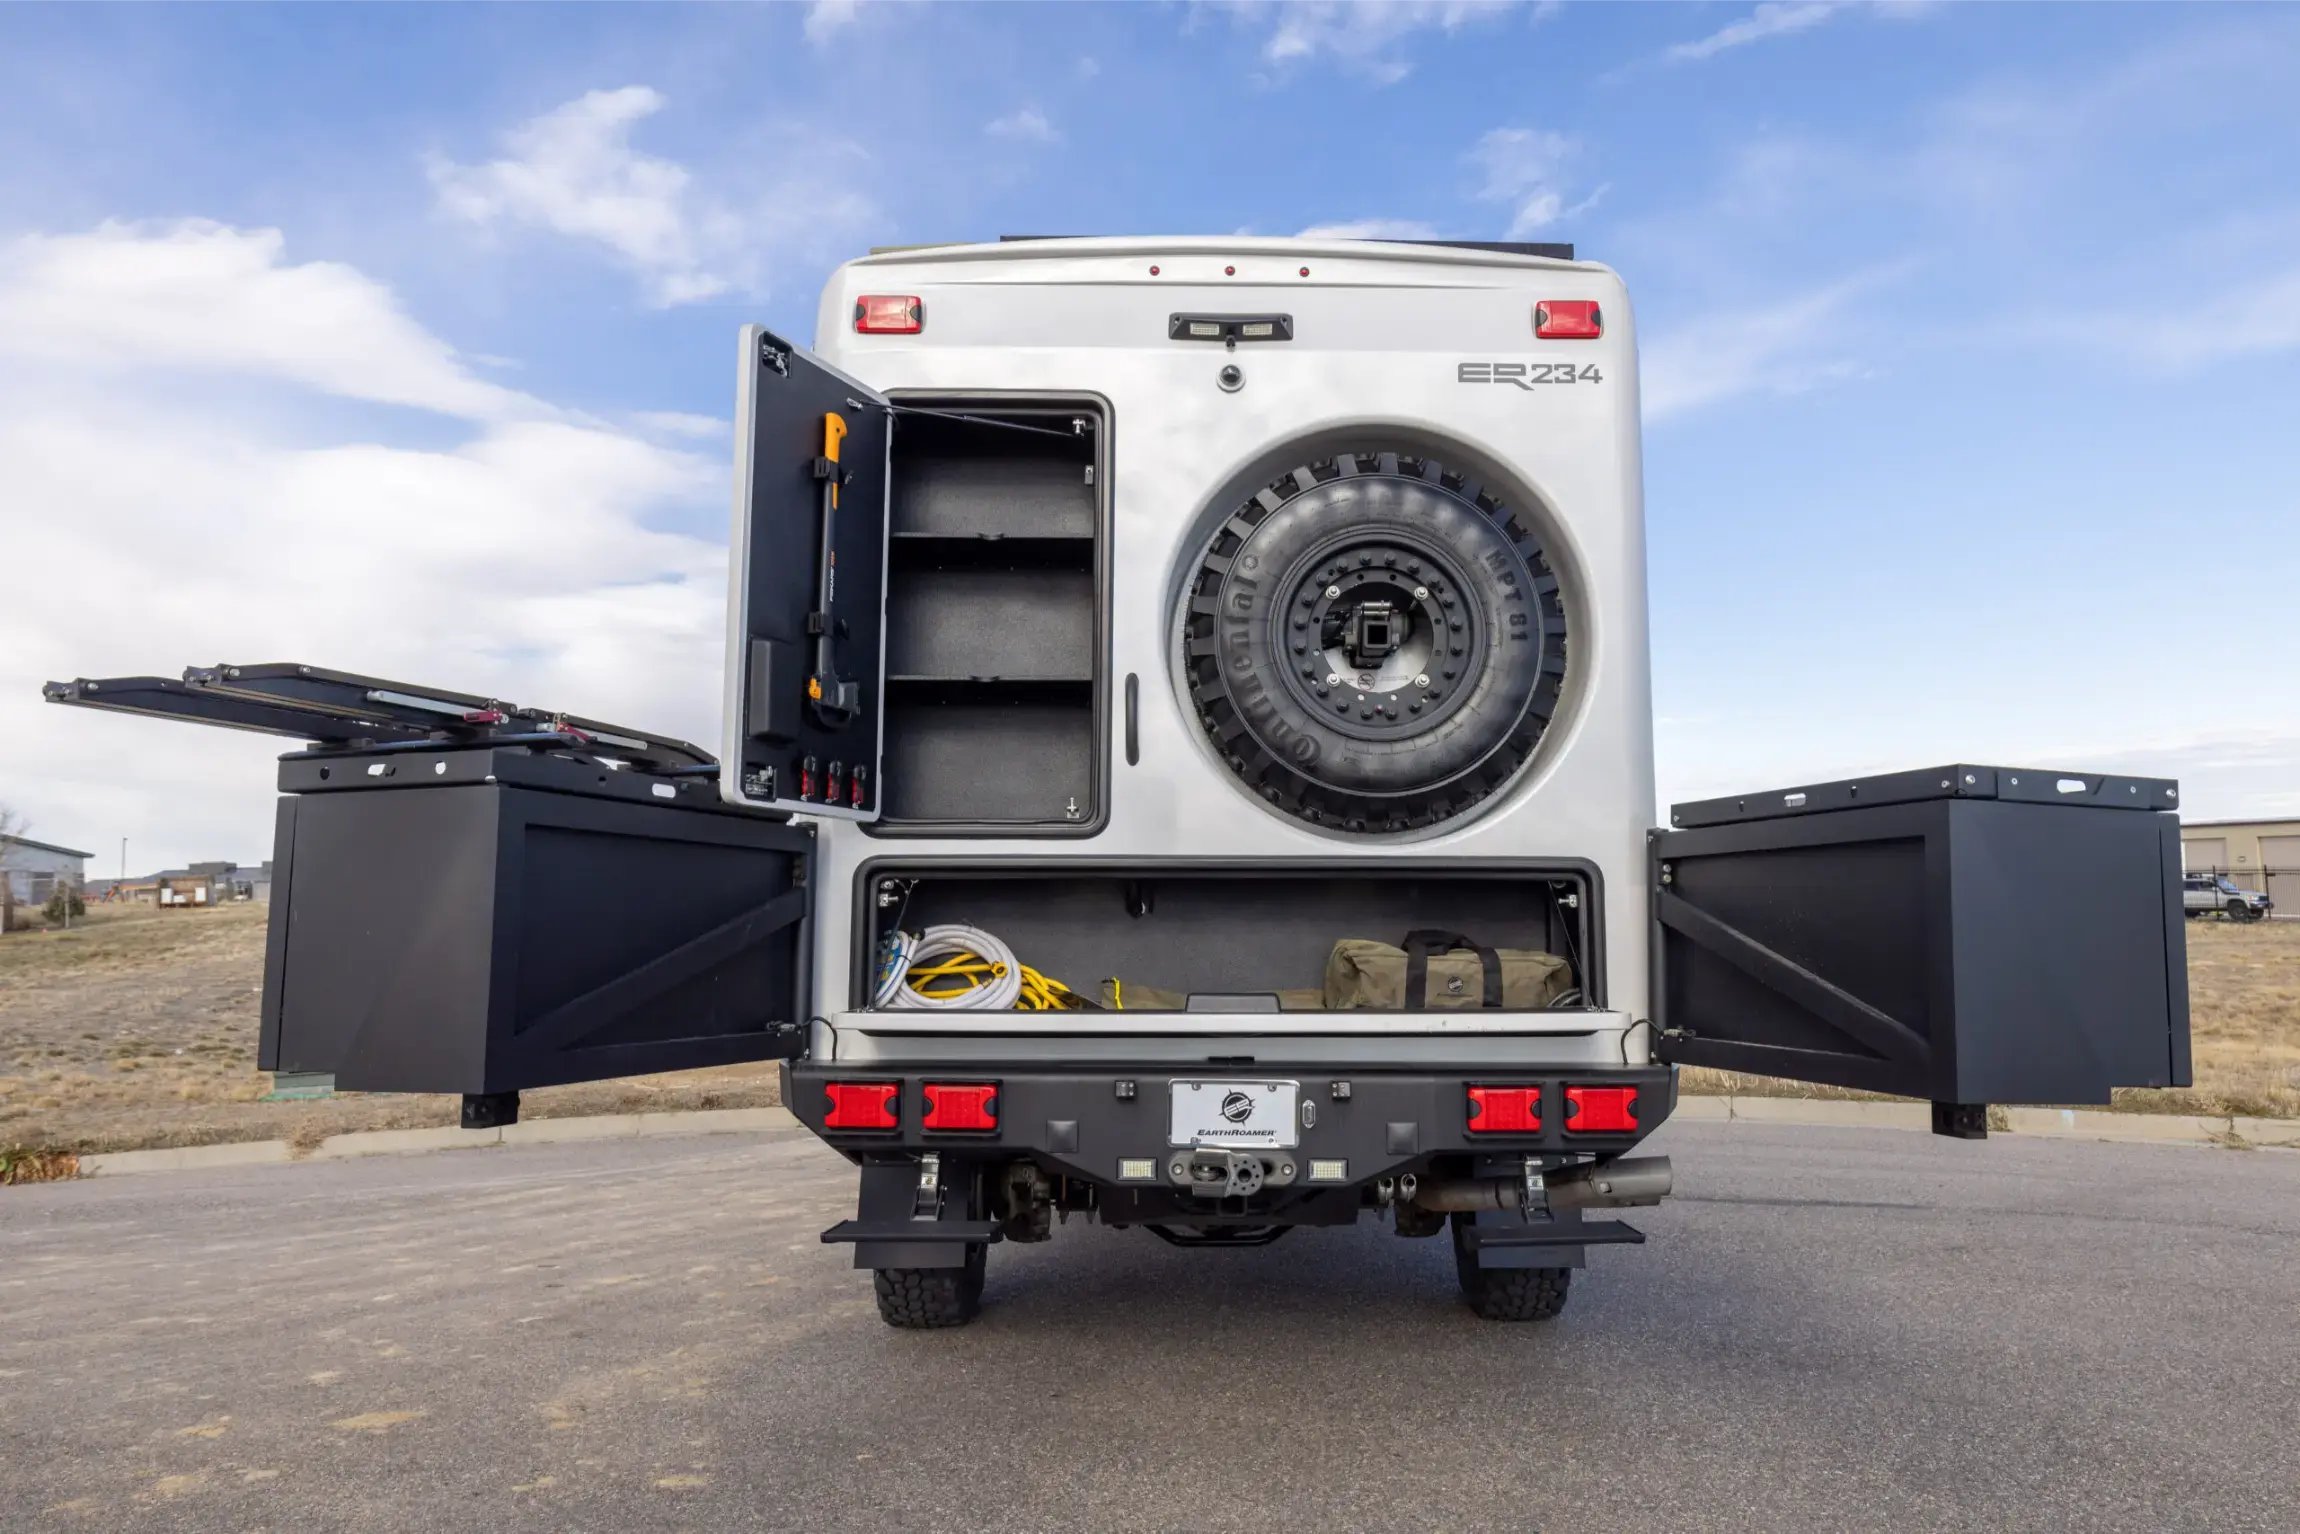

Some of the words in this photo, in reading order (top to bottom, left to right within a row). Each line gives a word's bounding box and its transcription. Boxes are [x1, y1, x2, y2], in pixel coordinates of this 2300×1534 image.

[1485, 549, 1522, 601] MPT
[1509, 613, 1528, 641] 81
[1225, 575, 1322, 768] Continental
